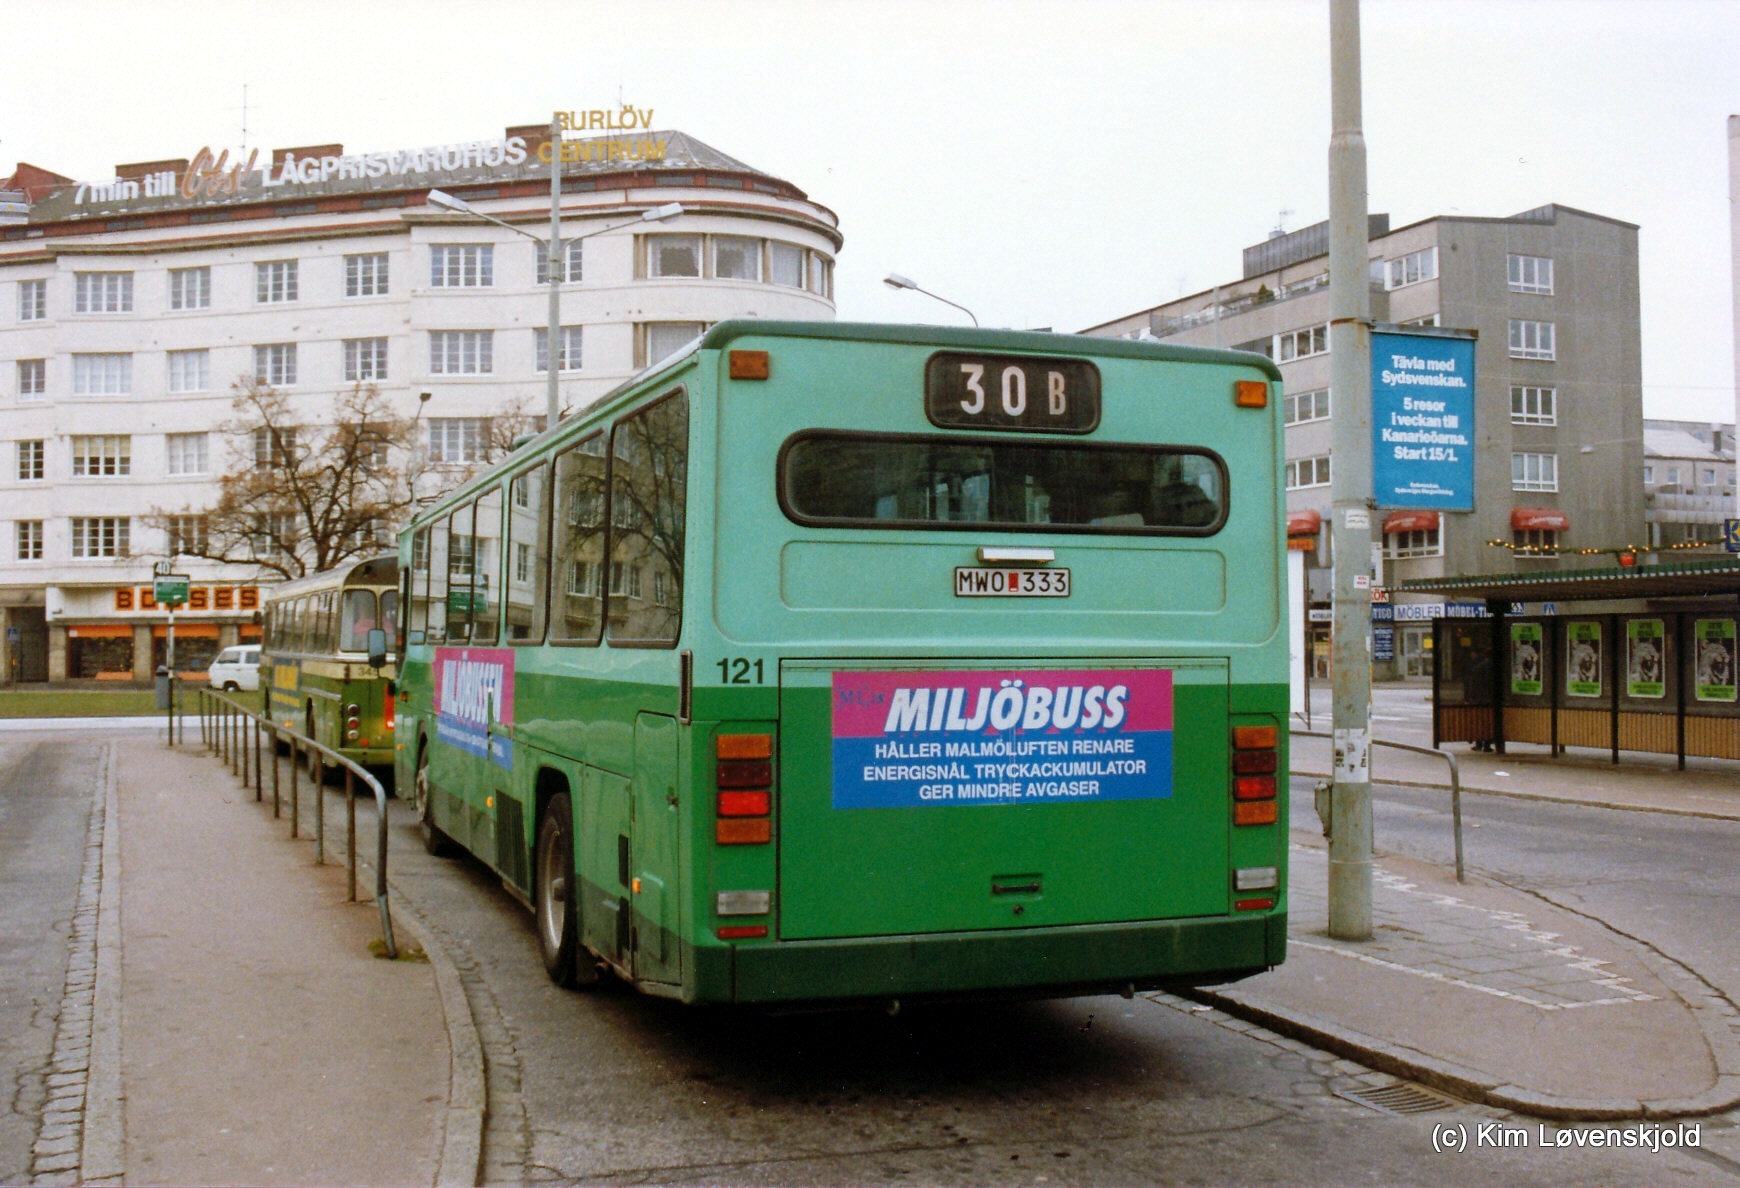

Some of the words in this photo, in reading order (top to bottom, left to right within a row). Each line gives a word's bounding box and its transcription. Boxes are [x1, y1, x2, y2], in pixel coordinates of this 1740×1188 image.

[553, 104, 654, 131] BURLÖV
[537, 140, 666, 163] CENTRUM
[91, 177, 139, 203] min
[143, 171, 176, 198] till
[262, 136, 527, 188] LÅGPRISVARUHUS
[1391, 355, 1425, 370] Tävla
[1427, 359, 1455, 372] med
[1382, 370, 1467, 387] Sydsvenskan.
[960, 363, 1027, 417] 30
[1048, 371, 1067, 415] B
[1403, 397, 1412, 410] 5
[1413, 400, 1446, 412] resor
[1391, 412, 1397, 426] i
[1397, 414, 1442, 428] veckan
[1443, 415, 1459, 429] till
[1382, 428, 1468, 446] Kanarieöarna.
[1393, 446, 1427, 461] Start
[1428, 447, 1458, 462] 15/1.
[959, 571, 1004, 592] MWO
[1023, 571, 1066, 592] 333
[116, 588, 258, 610] BOSES
[1397, 605, 1442, 619] MÖBLER
[716, 657, 764, 684] 121
[883, 679, 1129, 733] MILJÖBUSS
[875, 741, 941, 759] HÅLLER
[946, 739, 1069, 758] MALMÖLUFTEN
[1072, 739, 1135, 755] RENARE
[863, 762, 970, 781] ENERGISNÅL
[974, 760, 1147, 779] TRYCKACKUMULATOR
[919, 785, 954, 800] GER
[957, 783, 1022, 799] MINDRE
[1026, 781, 1100, 797] AVGASER
